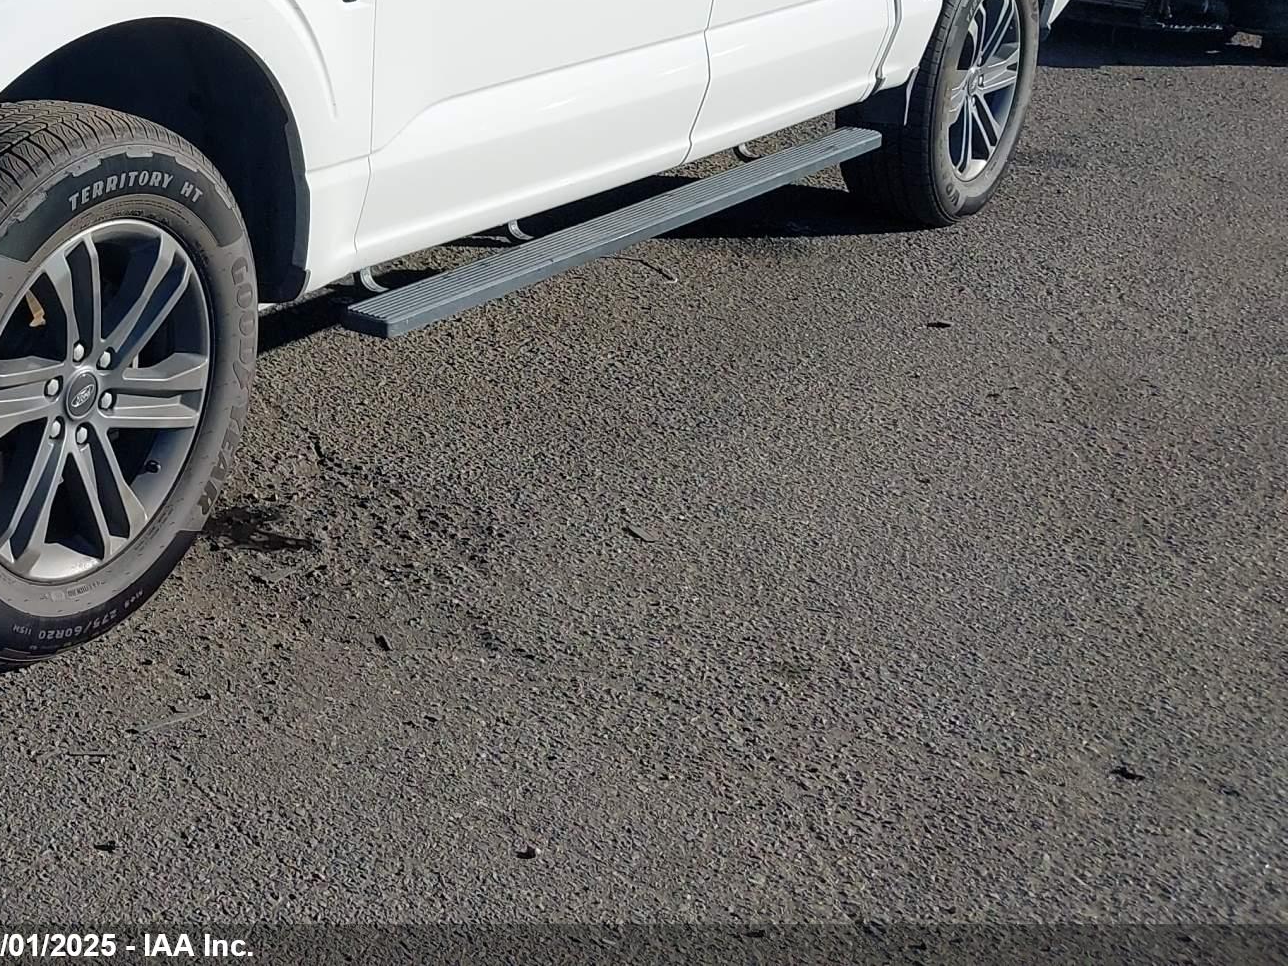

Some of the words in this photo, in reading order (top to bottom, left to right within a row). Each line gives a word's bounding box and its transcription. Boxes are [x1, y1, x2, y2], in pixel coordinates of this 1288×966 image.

[68, 170, 174, 212] TERRITORY
[180, 181, 204, 203] HT
[198, 256, 255, 516] GOODYEAR
[38, 609, 118, 640] 275/60R20
